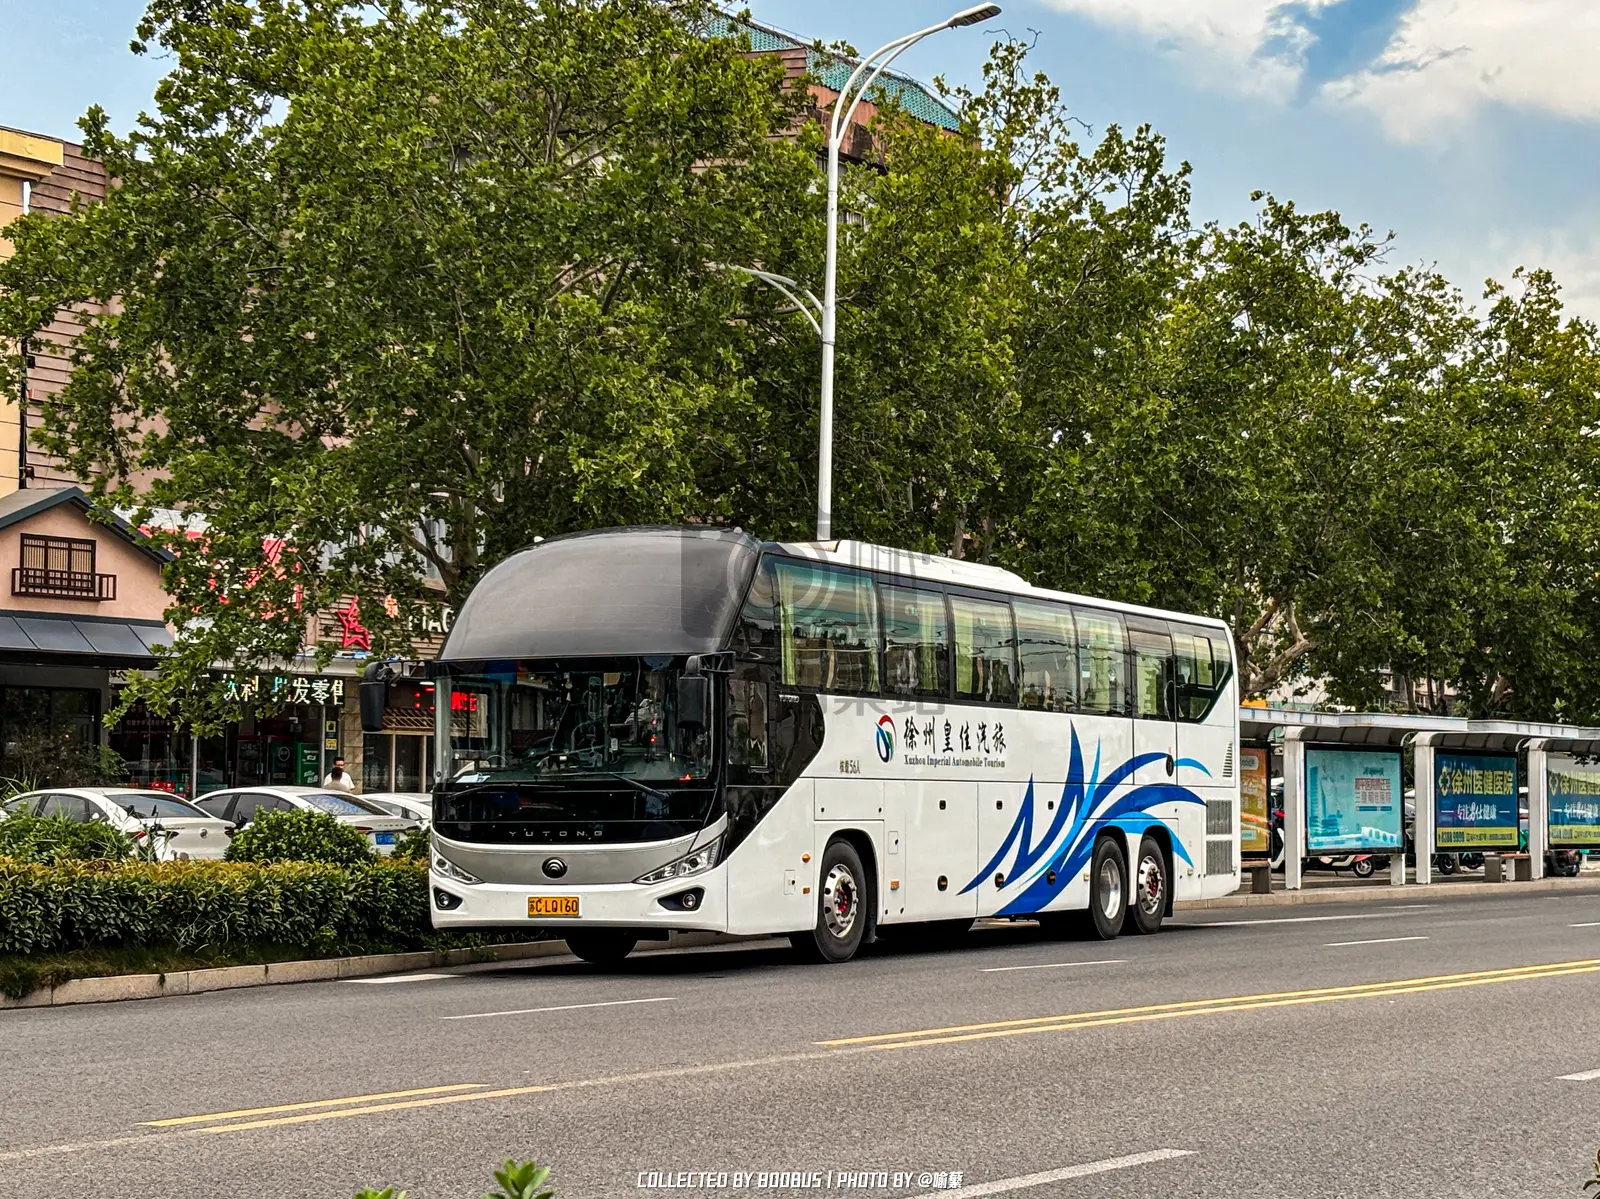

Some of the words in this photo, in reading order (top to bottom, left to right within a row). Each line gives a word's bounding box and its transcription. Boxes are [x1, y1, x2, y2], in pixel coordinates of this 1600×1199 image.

[903, 715, 1007, 754] 徐州皇佳汽旅
[904, 754, 926, 766] Xuzhou
[927, 755, 951, 768] Imperial
[952, 756, 983, 768] Automobile
[984, 757, 1006, 768] Tourism
[1451, 768, 1514, 796] 徐州医健医院
